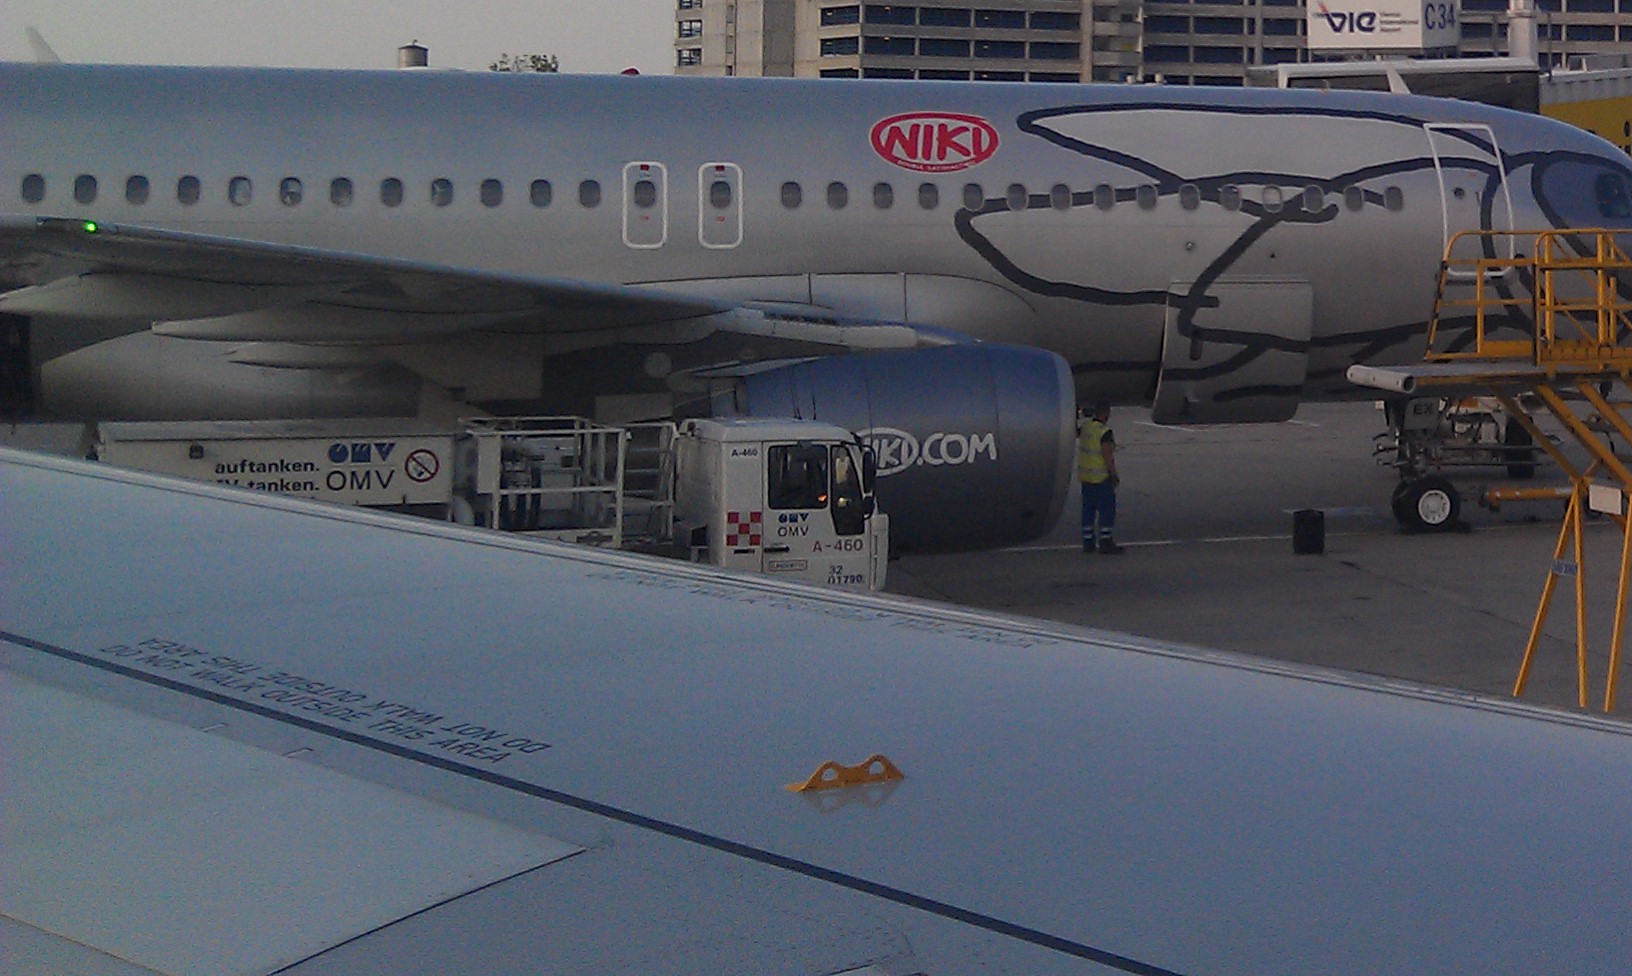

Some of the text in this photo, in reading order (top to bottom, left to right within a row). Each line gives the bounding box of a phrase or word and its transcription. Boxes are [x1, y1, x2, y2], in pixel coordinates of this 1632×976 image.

[1424, 3, 1456, 30] C34
[883, 122, 983, 162] NIKI
[731, 448, 759, 457] A-460
[214, 458, 320, 474] auftanken.
[326, 470, 396, 492] OMV
[777, 526, 809, 537] OMV
[812, 539, 864, 552] A-460
[830, 565, 843, 574] 32
